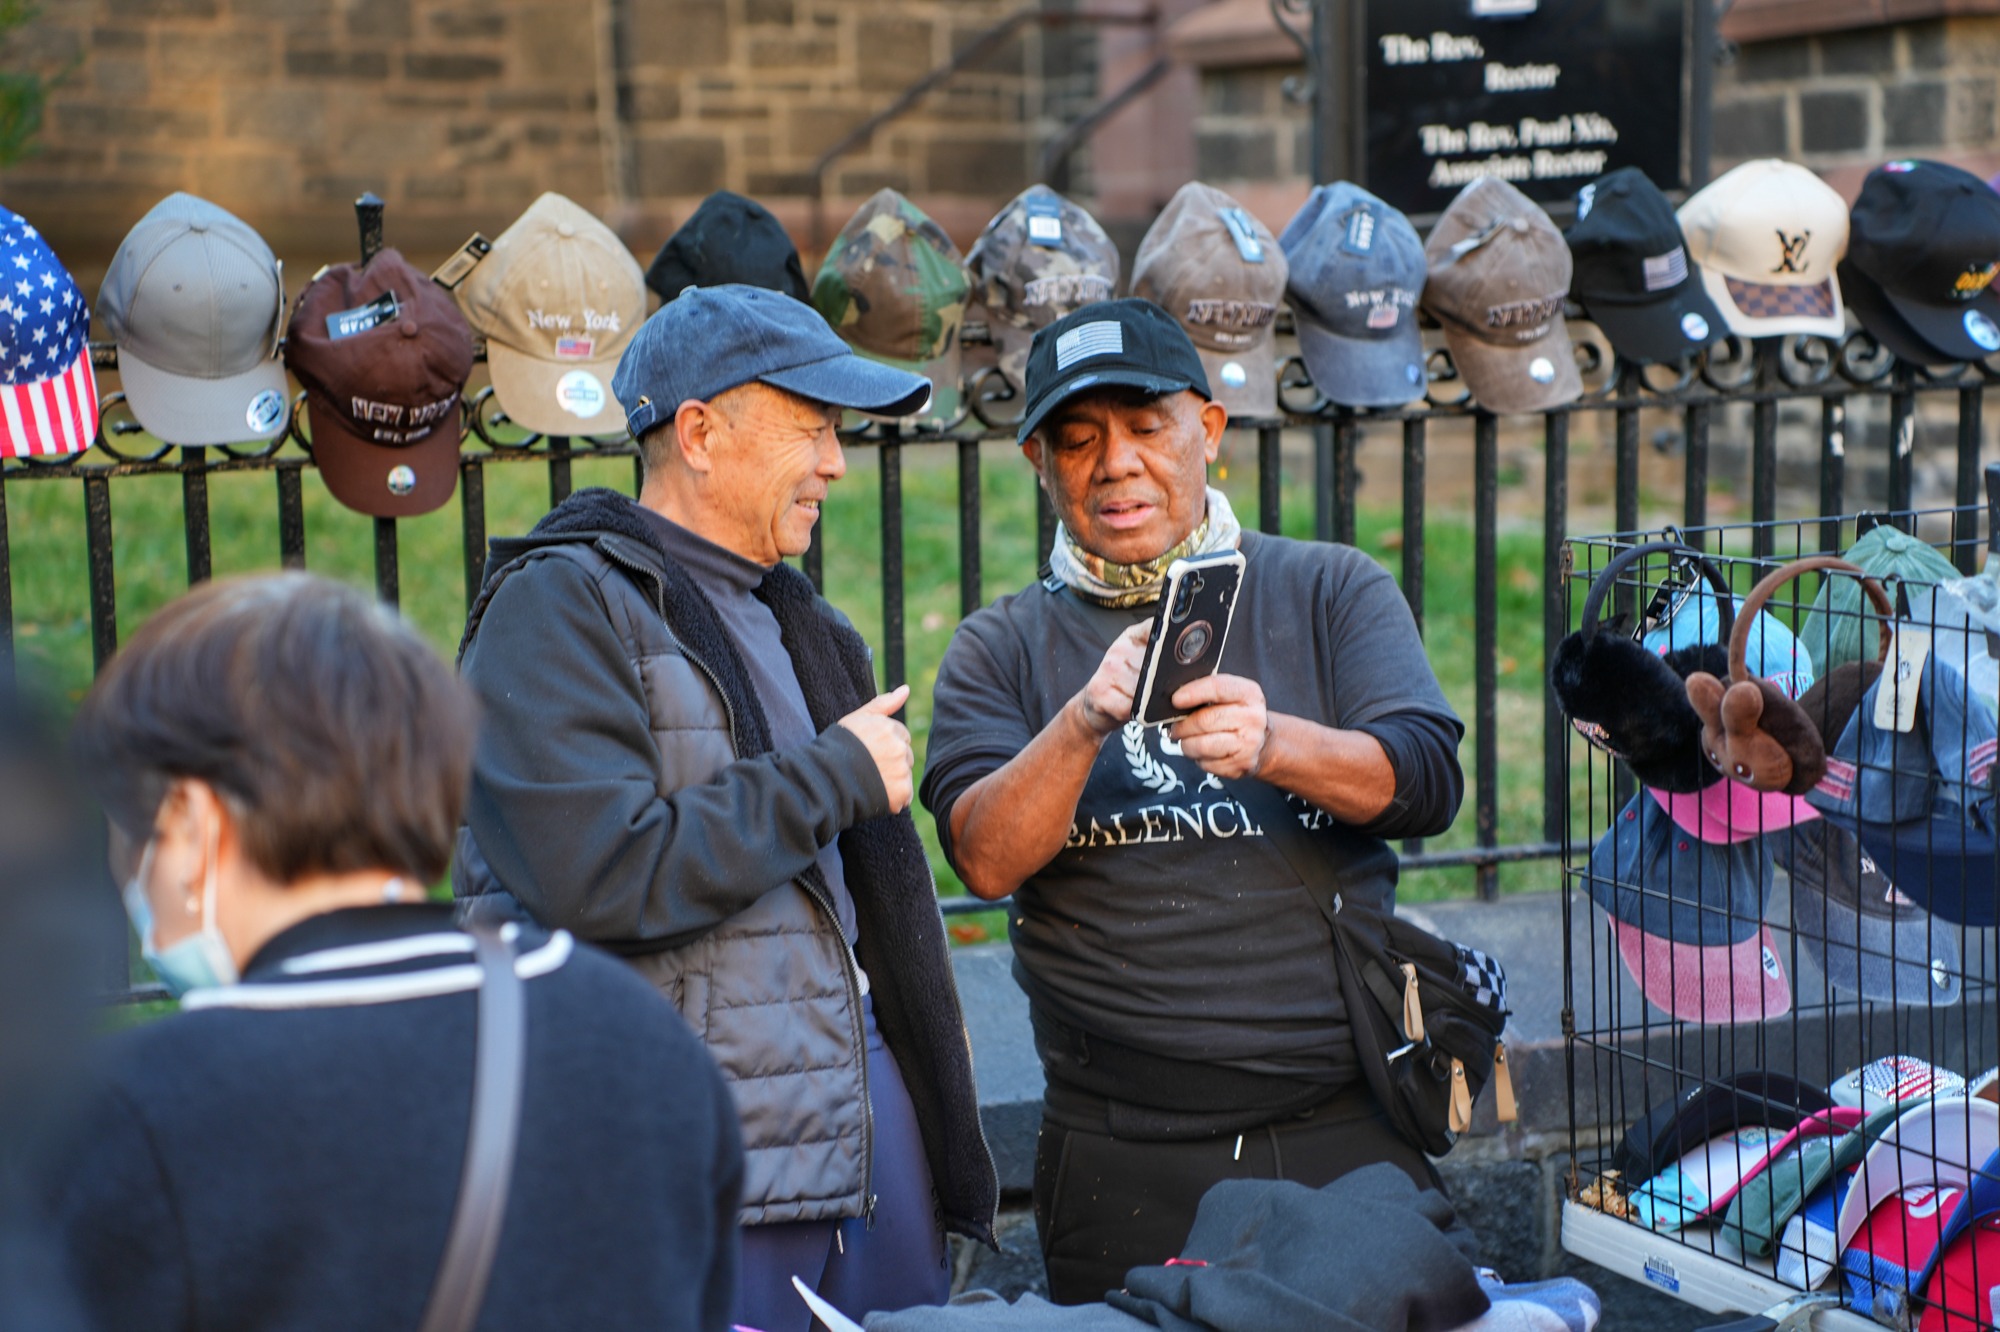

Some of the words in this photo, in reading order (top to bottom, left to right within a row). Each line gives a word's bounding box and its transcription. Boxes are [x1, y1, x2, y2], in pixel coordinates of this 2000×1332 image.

[1379, 34, 1430, 65] The
[1431, 31, 1485, 61] Rev.
[1484, 62, 1561, 92] Rector
[1418, 124, 1467, 155] The
[1468, 121, 1518, 151] Rev.
[1519, 115, 1571, 147] Paul
[1428, 154, 1532, 188] Associate
[1532, 149, 1608, 180] Rector
[526, 308, 571, 329] New
[583, 309, 620, 332] York
